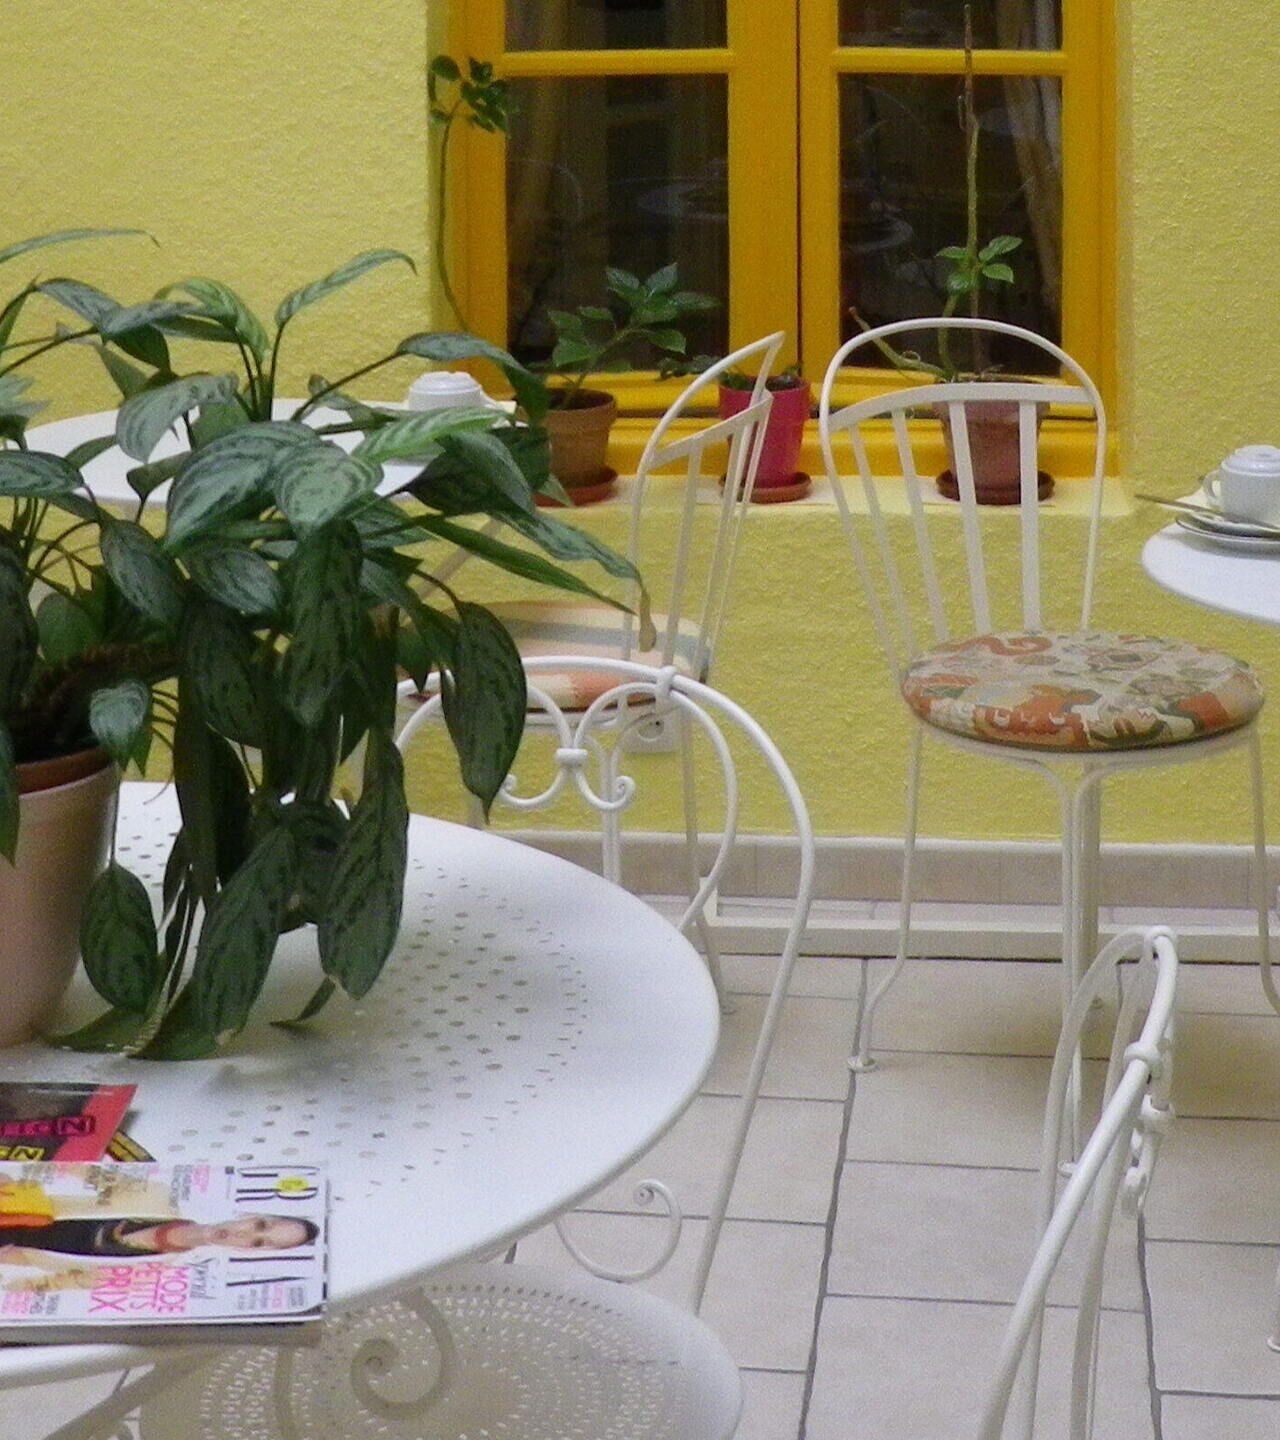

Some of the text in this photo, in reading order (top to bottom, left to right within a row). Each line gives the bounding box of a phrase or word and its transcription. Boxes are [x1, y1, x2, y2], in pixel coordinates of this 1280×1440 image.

[88, 1265, 132, 1313] PRIX
[129, 1262, 163, 1311] PETITS
[158, 1265, 193, 1313] MODE
